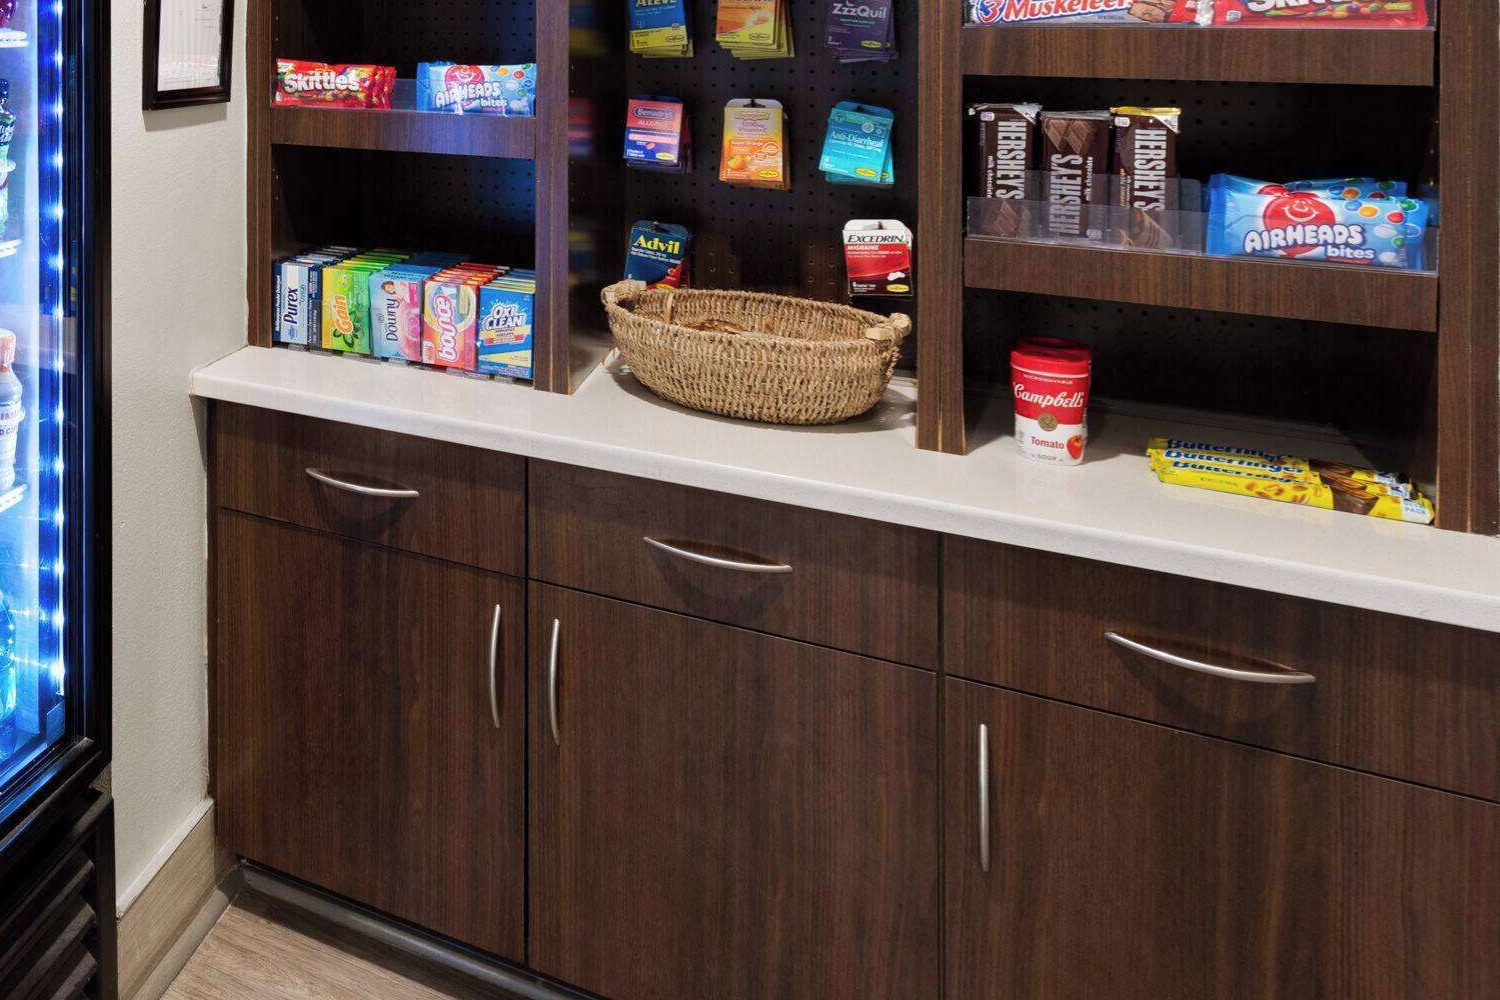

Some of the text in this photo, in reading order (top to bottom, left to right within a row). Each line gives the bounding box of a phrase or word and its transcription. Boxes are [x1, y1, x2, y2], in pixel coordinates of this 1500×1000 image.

[832, 1, 886, 19] ZzzQuil
[284, 72, 360, 93] Skittles
[435, 81, 500, 108] AIRHEADS
[480, 97, 508, 108] bites
[830, 131, 883, 148] Anti-Diarrheal
[995, 120, 1027, 200] HERSHEY'S
[1086, 156, 1094, 187] chocolate
[1133, 129, 1167, 211] HERSHEY'S
[1049, 153, 1083, 235] HERSHEY'S
[632, 234, 680, 255] Advil
[847, 234, 904, 243] EXCEDRIN
[1244, 224, 1365, 254] AIRHEADS
[1324, 245, 1375, 262] bites
[283, 287, 299, 325] Purex
[333, 295, 353, 333] Gain
[492, 305, 516, 318] OXI
[386, 298, 400, 342] Downy
[484, 315, 525, 331] CLEAN
[1013, 382, 1085, 408] Campbell's
[1030, 436, 1065, 450] Tomato
